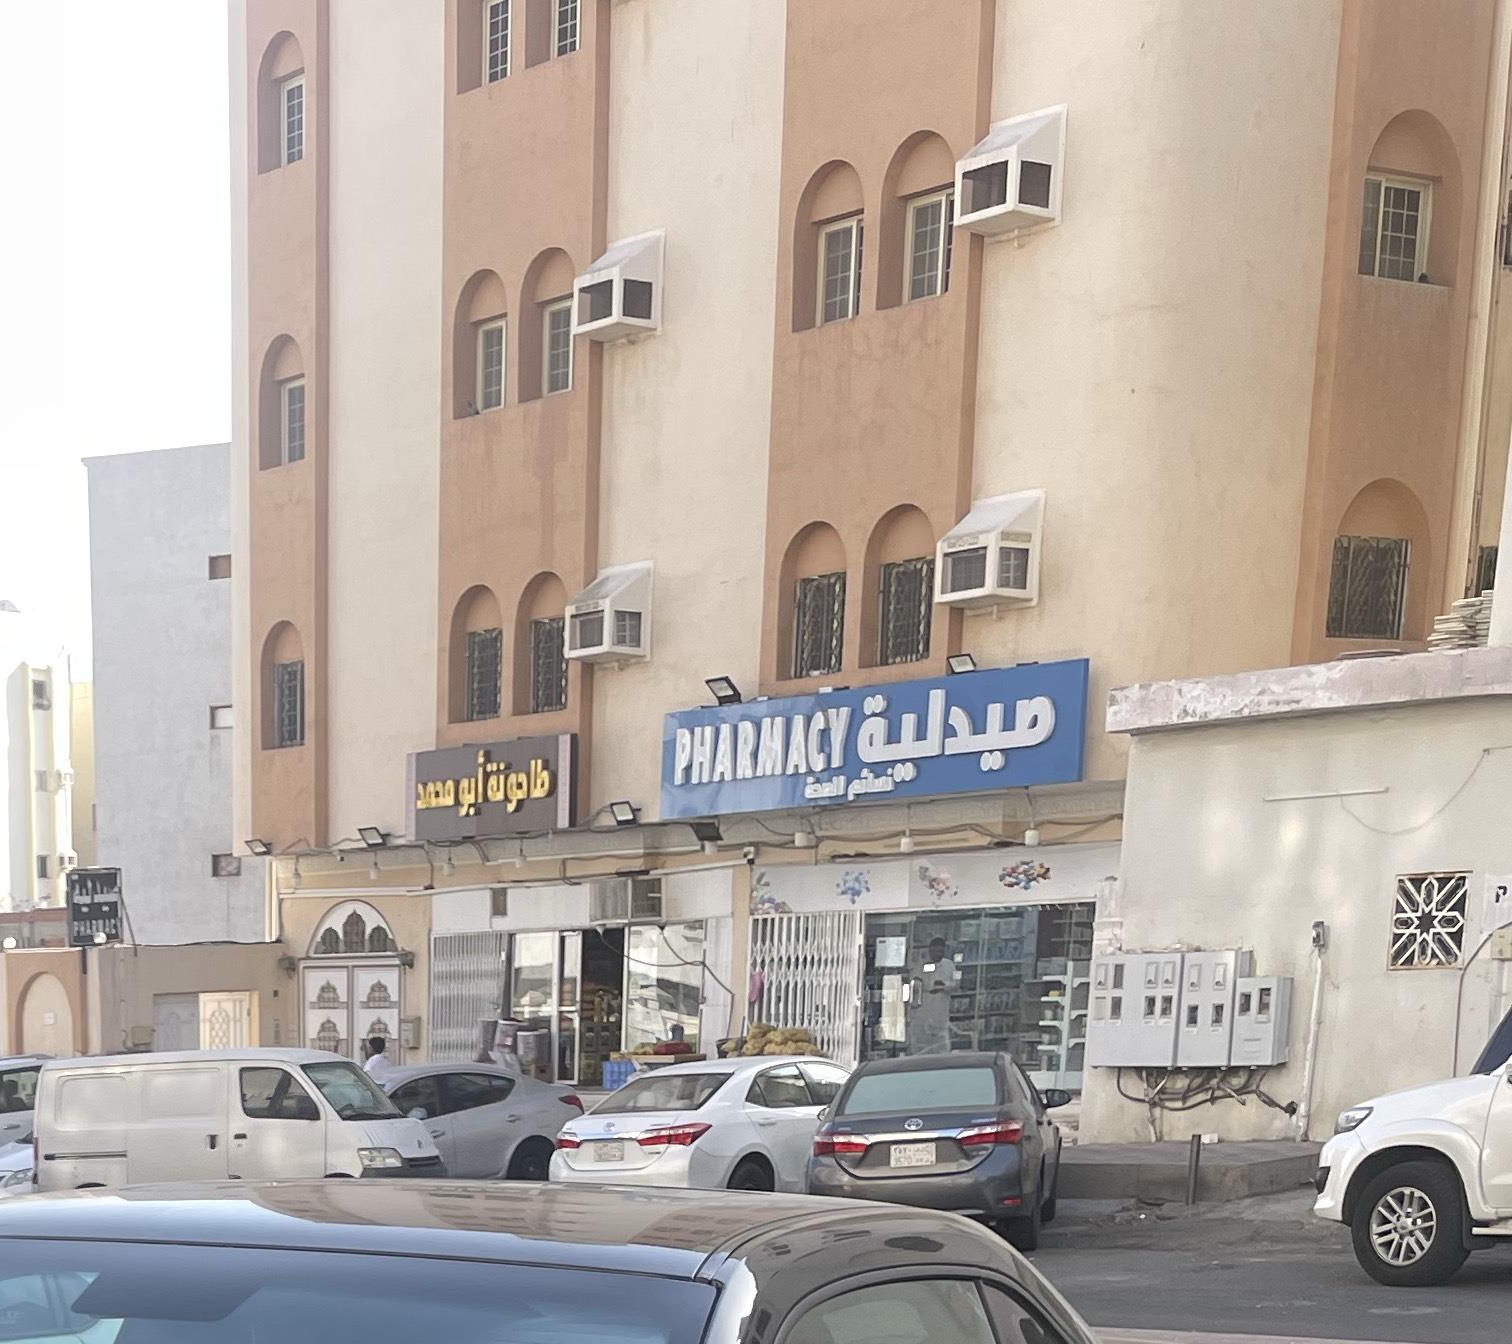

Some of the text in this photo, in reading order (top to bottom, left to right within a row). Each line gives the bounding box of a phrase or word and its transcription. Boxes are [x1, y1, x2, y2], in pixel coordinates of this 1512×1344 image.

[674, 706, 851, 785] PHARMACY
[857, 688, 1056, 778] صيدلية
[416, 779, 456, 810] محمد
[458, 749, 485, 817] أبو
